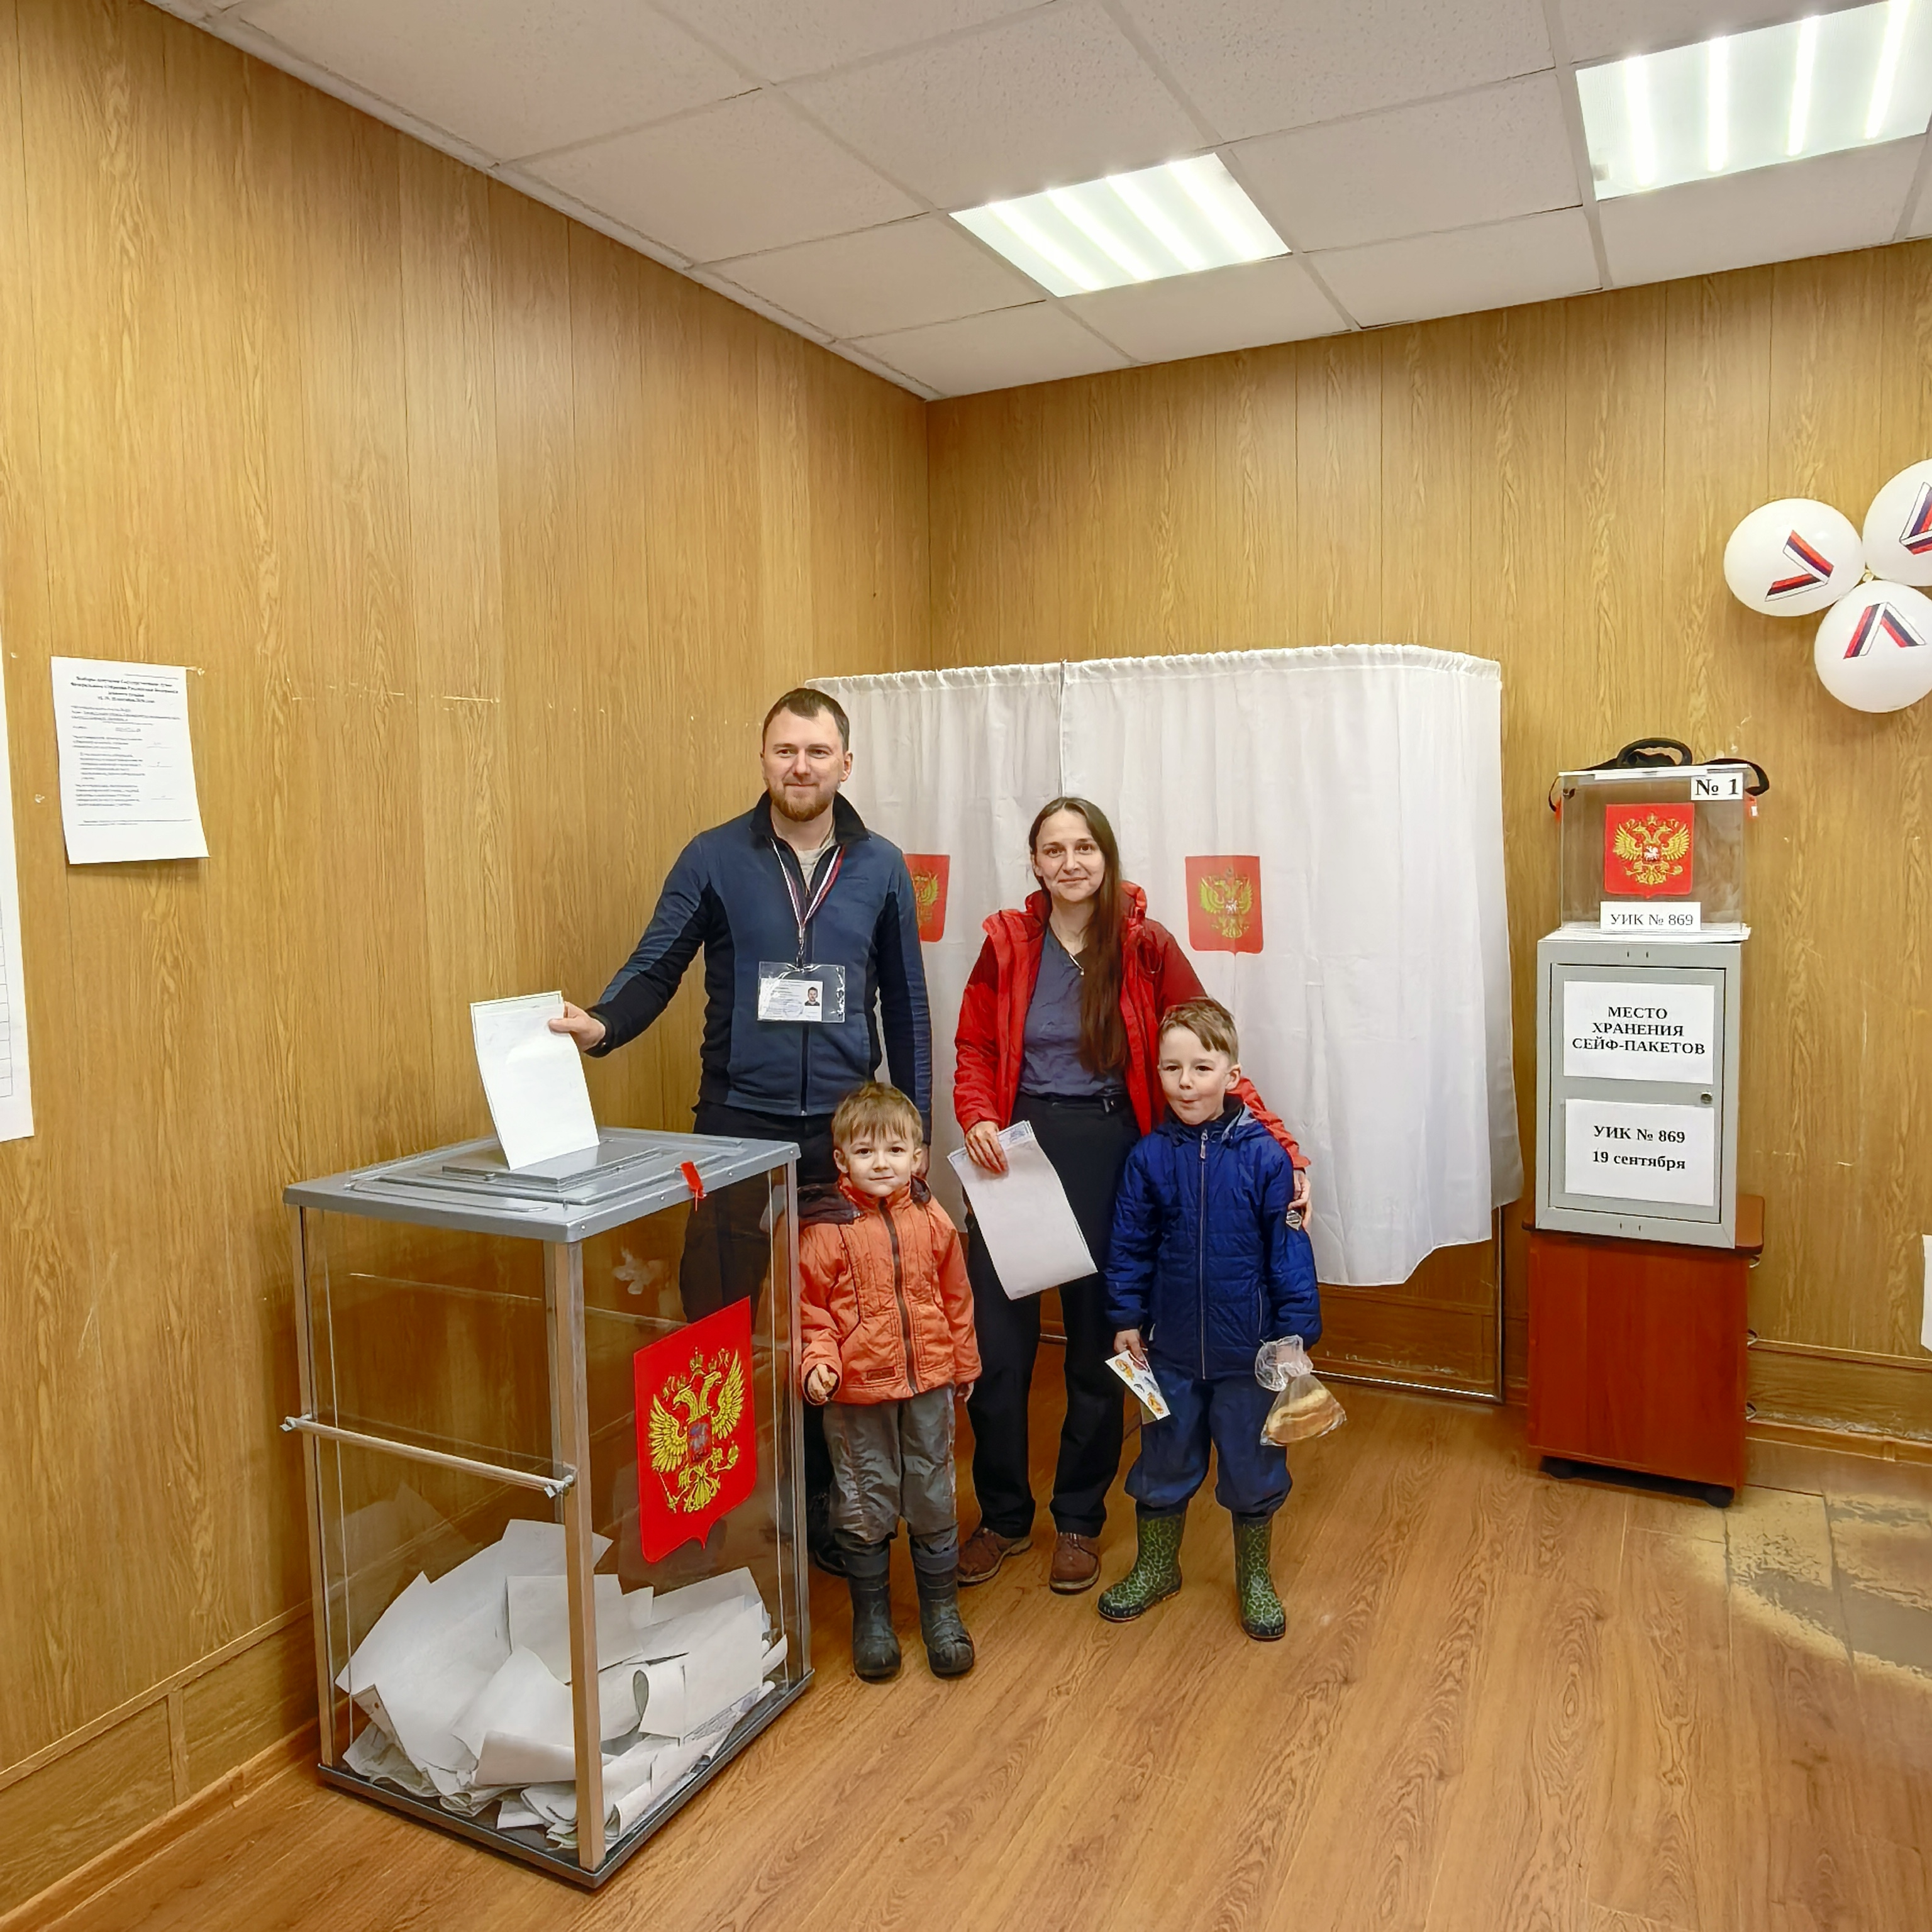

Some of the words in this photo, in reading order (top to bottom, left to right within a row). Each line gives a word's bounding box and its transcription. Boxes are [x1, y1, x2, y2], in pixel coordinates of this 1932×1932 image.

[1696, 779, 1719, 796] №
[1729, 779, 1739, 795] 1
[1611, 914, 1643, 925] УИК
[1649, 914, 1663, 926] №
[1668, 914, 1694, 925] 869
[1608, 1006, 1668, 1019] МЕСТО
[1592, 1022, 1684, 1037] ХРАНЕНИЯ
[1572, 1036, 1705, 1055] СЕЙФ-ПАКЕТОВ
[1594, 1125, 1631, 1140] УИК
[1636, 1128, 1653, 1141] №
[1658, 1130, 1685, 1143] 869
[1593, 1150, 1609, 1163] 19
[1613, 1153, 1685, 1171] сентября
